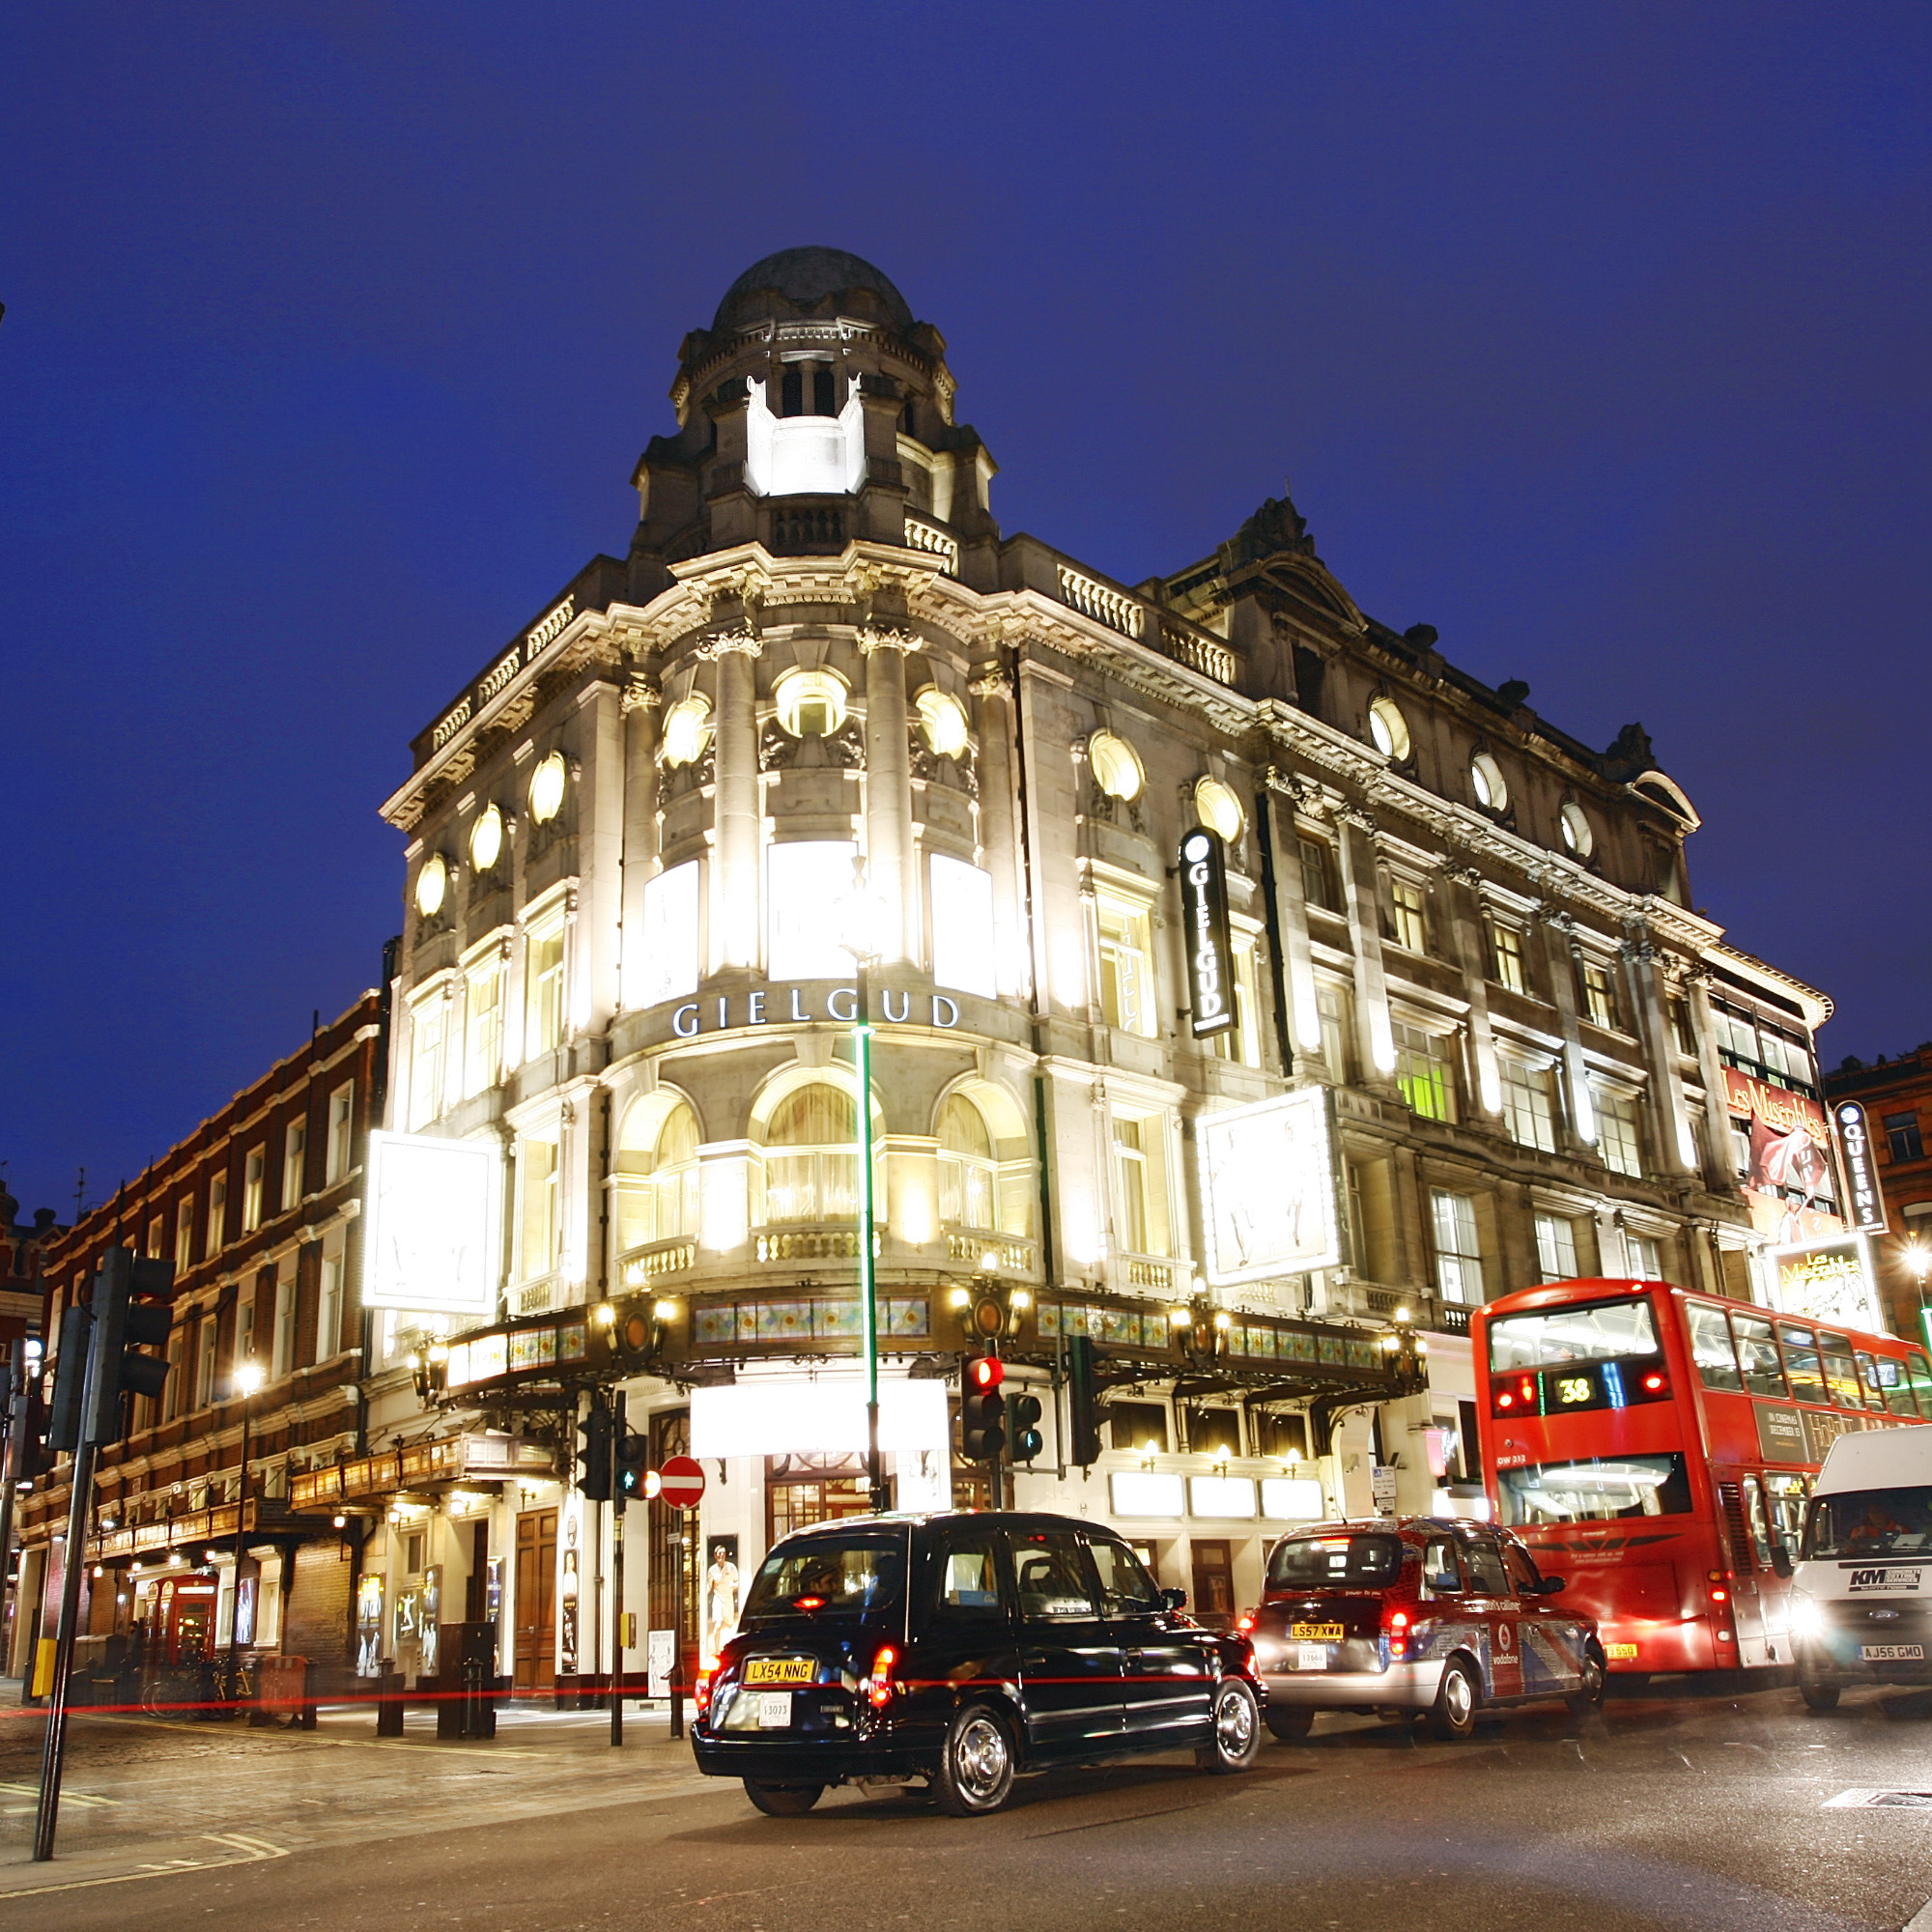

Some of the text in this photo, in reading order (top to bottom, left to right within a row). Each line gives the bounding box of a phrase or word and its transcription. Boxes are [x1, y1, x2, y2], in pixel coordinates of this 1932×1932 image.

[1189, 862, 1221, 1017] GIELGUD
[672, 987, 960, 1038] GIELGUD
[1720, 1069, 1751, 1113] Les
[1844, 1124, 1874, 1224] QUEENS
[1805, 1252, 1827, 1266] Les
[1559, 1378, 1590, 1403] 38
[1850, 1569, 1886, 1585] KM
[1292, 1626, 1318, 1637] LS57
[1493, 1655, 1519, 1665] vodafone
[1865, 1647, 1895, 1658] AJ56
[752, 1663, 809, 1679] LX54 NNG
